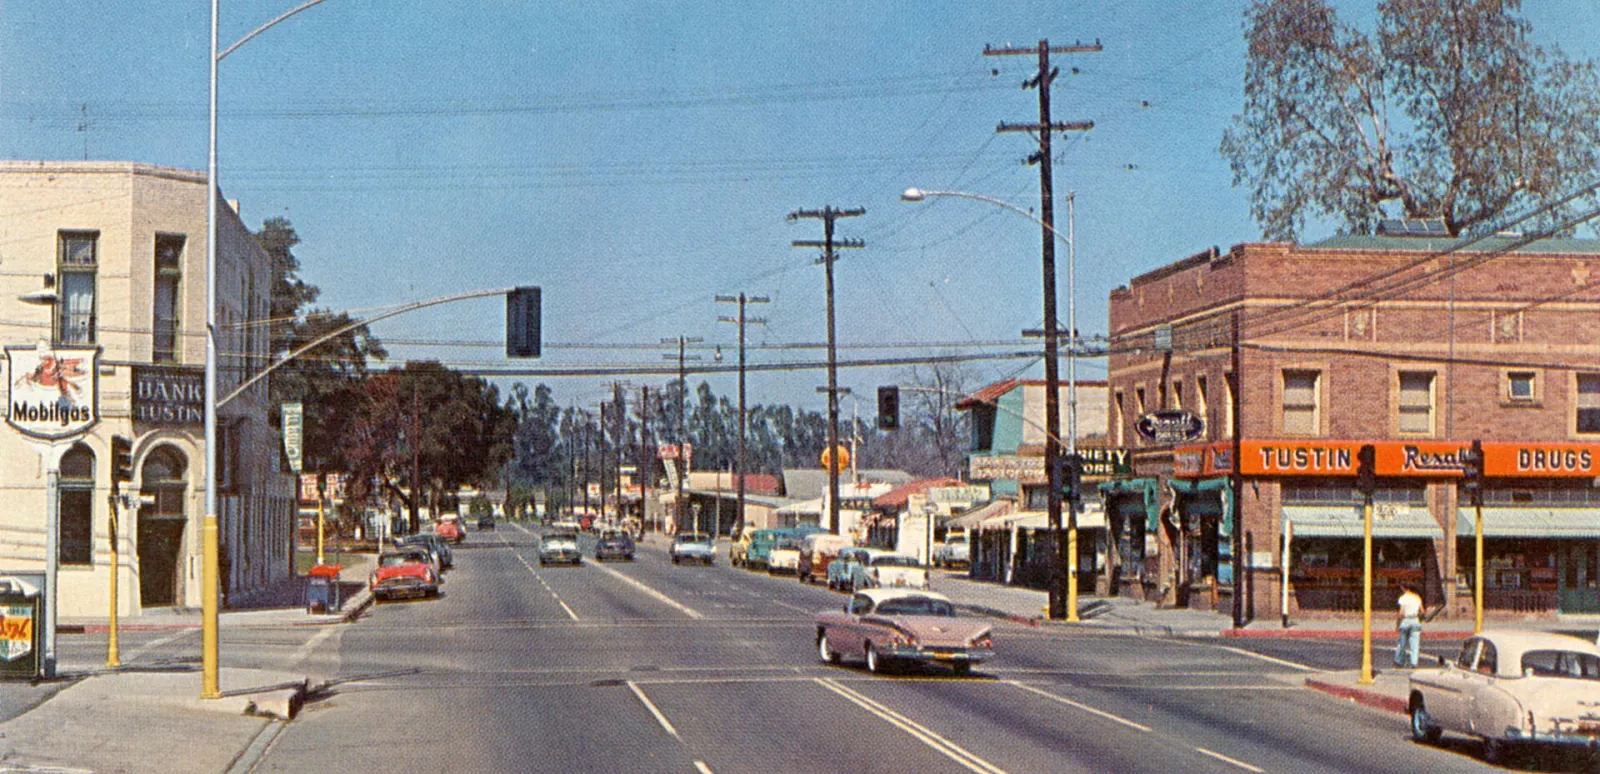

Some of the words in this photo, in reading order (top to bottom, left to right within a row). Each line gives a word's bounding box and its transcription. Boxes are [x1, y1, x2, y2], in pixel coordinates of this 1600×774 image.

[13, 399, 91, 426] Mobilgas
[1259, 447, 1351, 470] TUSTIN
[1517, 448, 1593, 472] DRUGS
